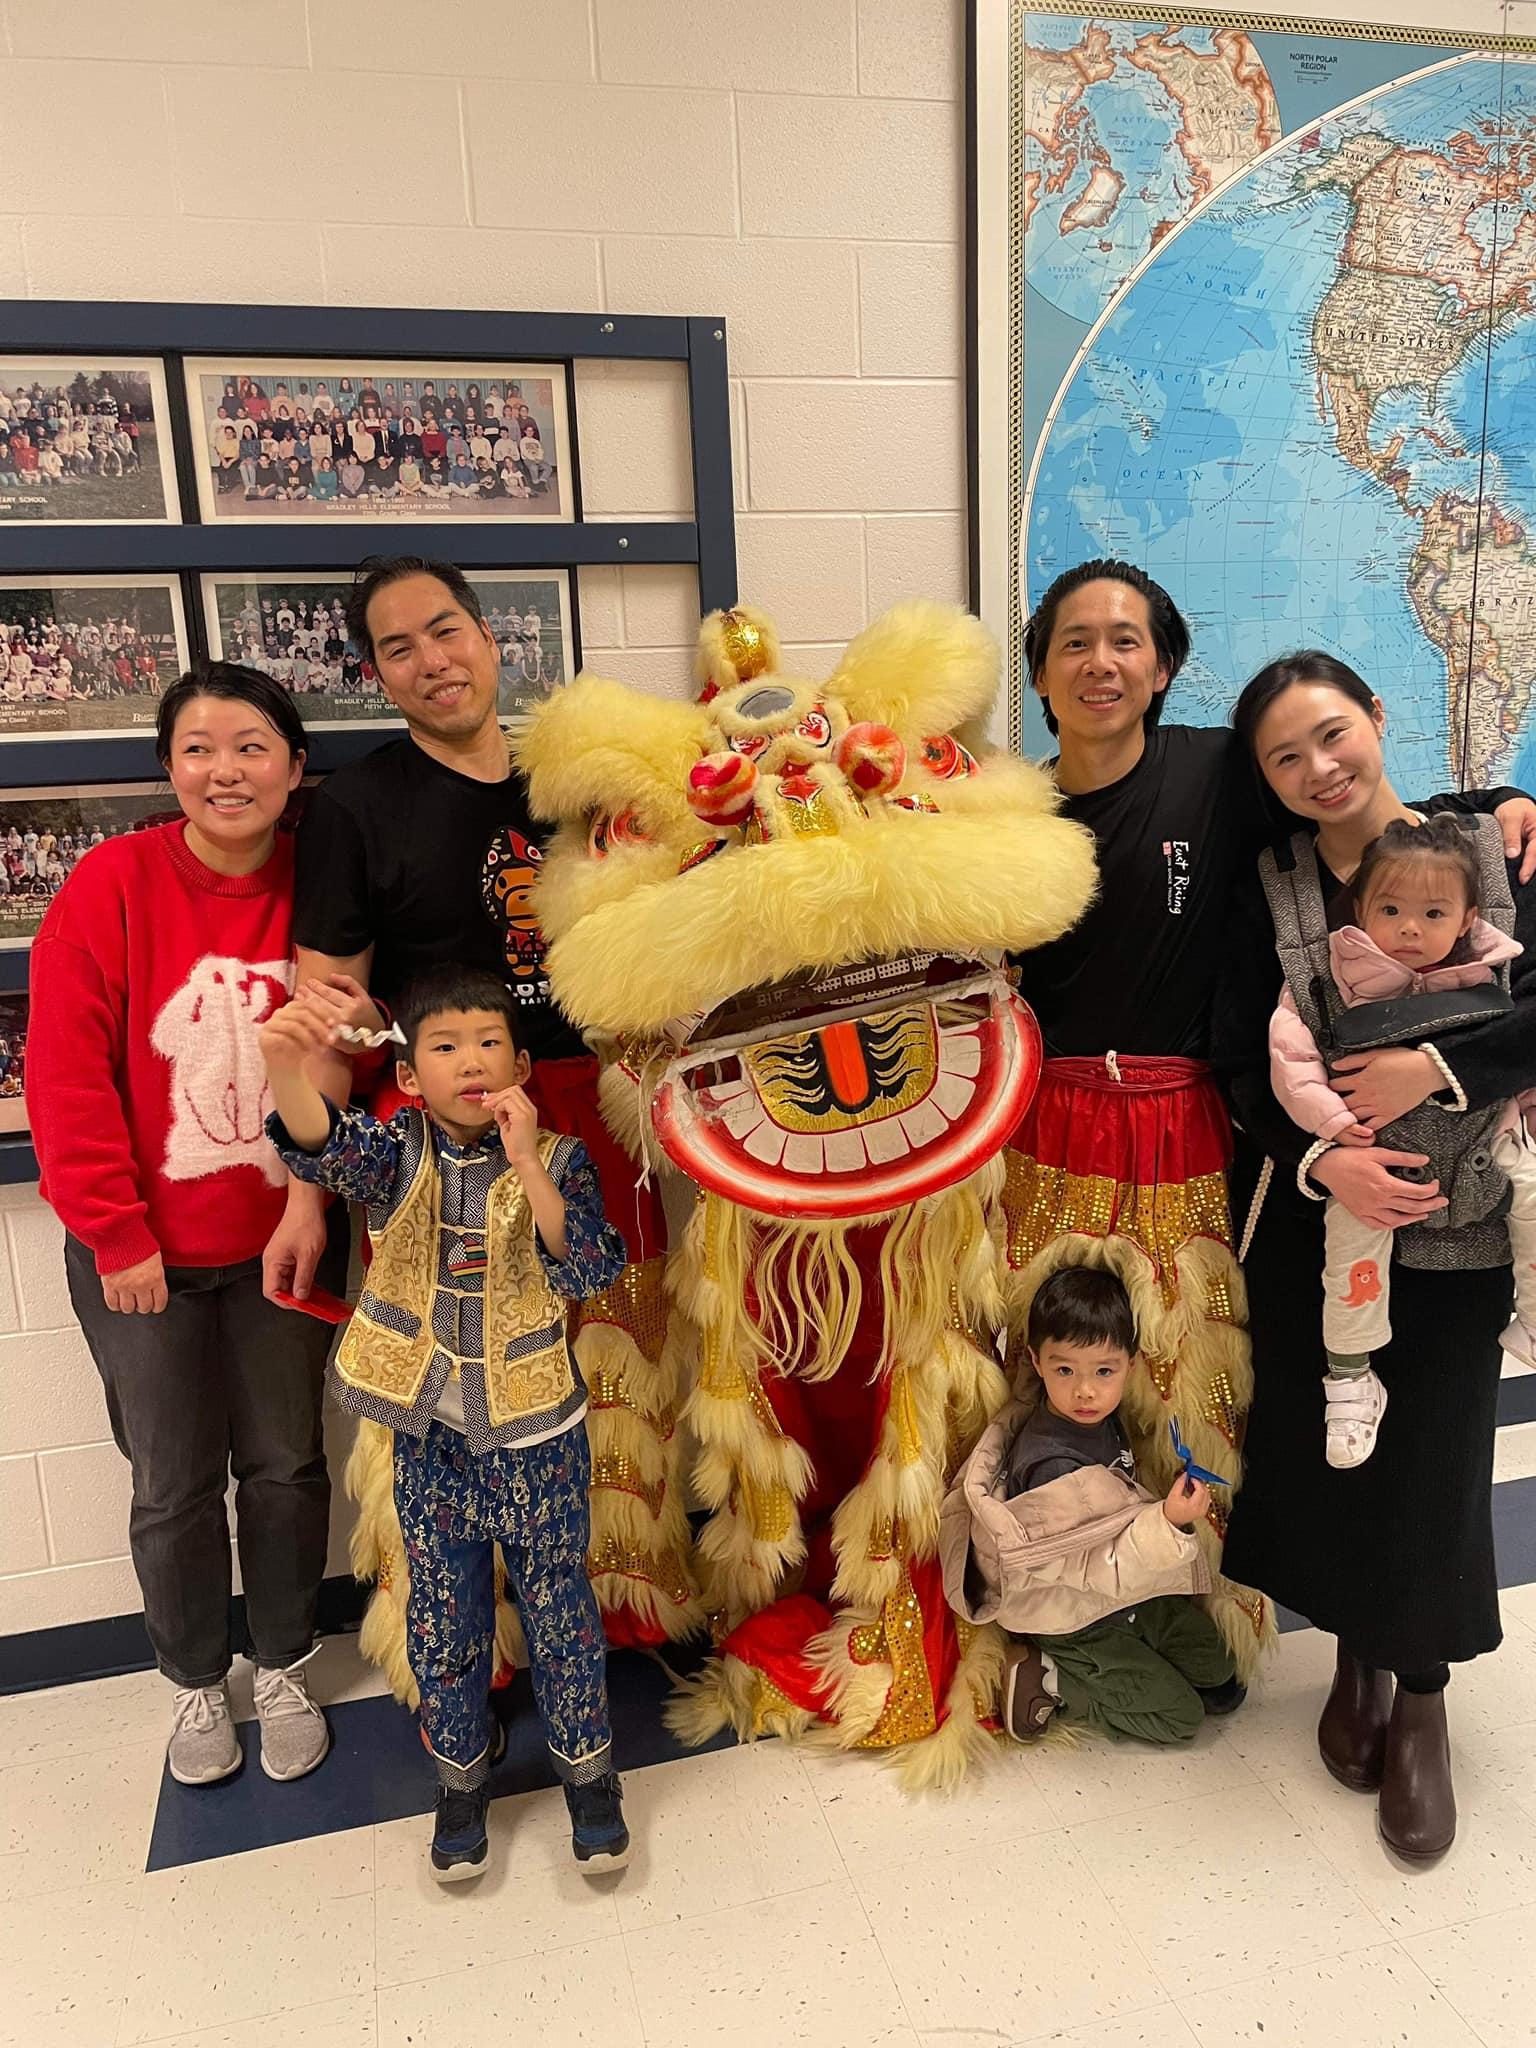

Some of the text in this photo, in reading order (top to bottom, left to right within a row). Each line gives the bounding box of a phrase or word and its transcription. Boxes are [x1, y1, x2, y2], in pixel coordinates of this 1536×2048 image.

[1289, 53, 1338, 64] NORTH POLAR
[1300, 62, 1327, 71] REGION
[1340, 151, 1371, 164] ALASKA
[1184, 271, 1267, 299] NORTH
[1325, 327, 1454, 350] UNITED STATES
[1138, 368, 1247, 390] PACIFIC
[1123, 469, 1203, 481] OCEAN
[1169, 840, 1190, 914] East Rising
